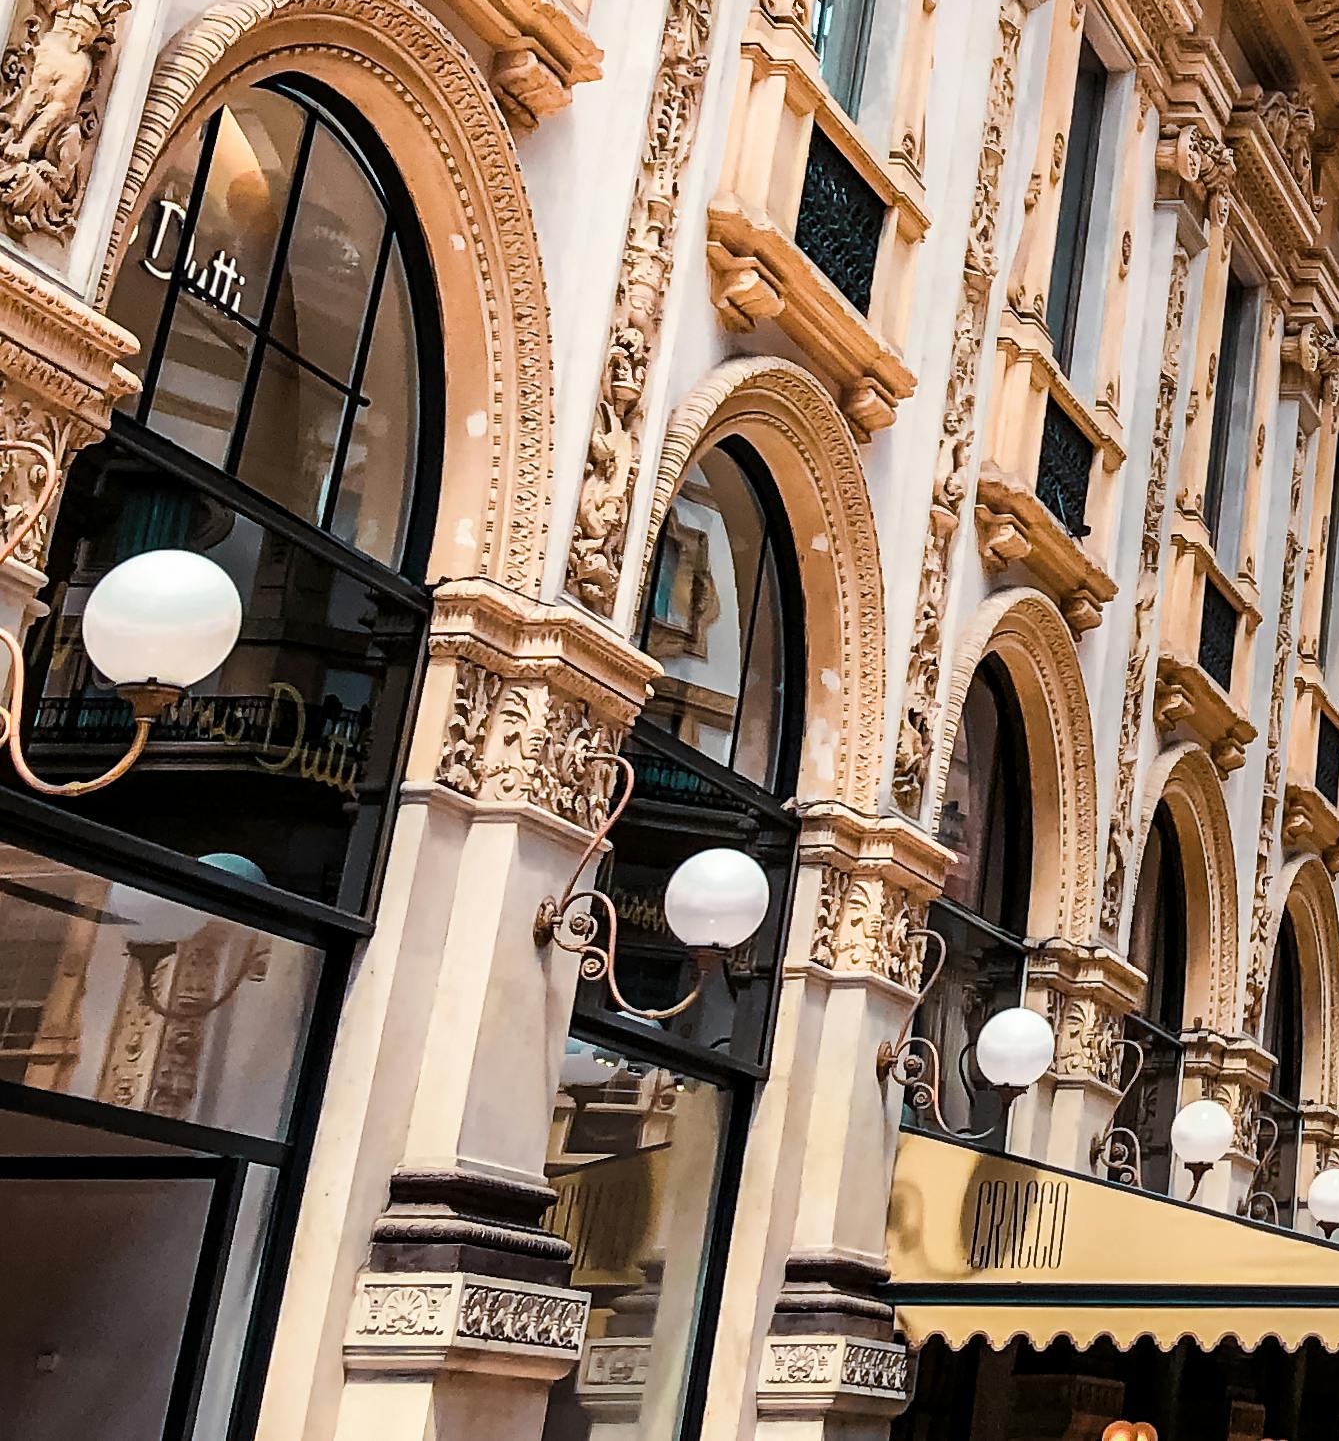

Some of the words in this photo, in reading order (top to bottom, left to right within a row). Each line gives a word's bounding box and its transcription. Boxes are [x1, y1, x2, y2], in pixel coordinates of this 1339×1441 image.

[144, 199, 246, 314] Dutti
[254, 680, 364, 801] Dutti
[970, 1179, 1069, 1270] CRACCO
